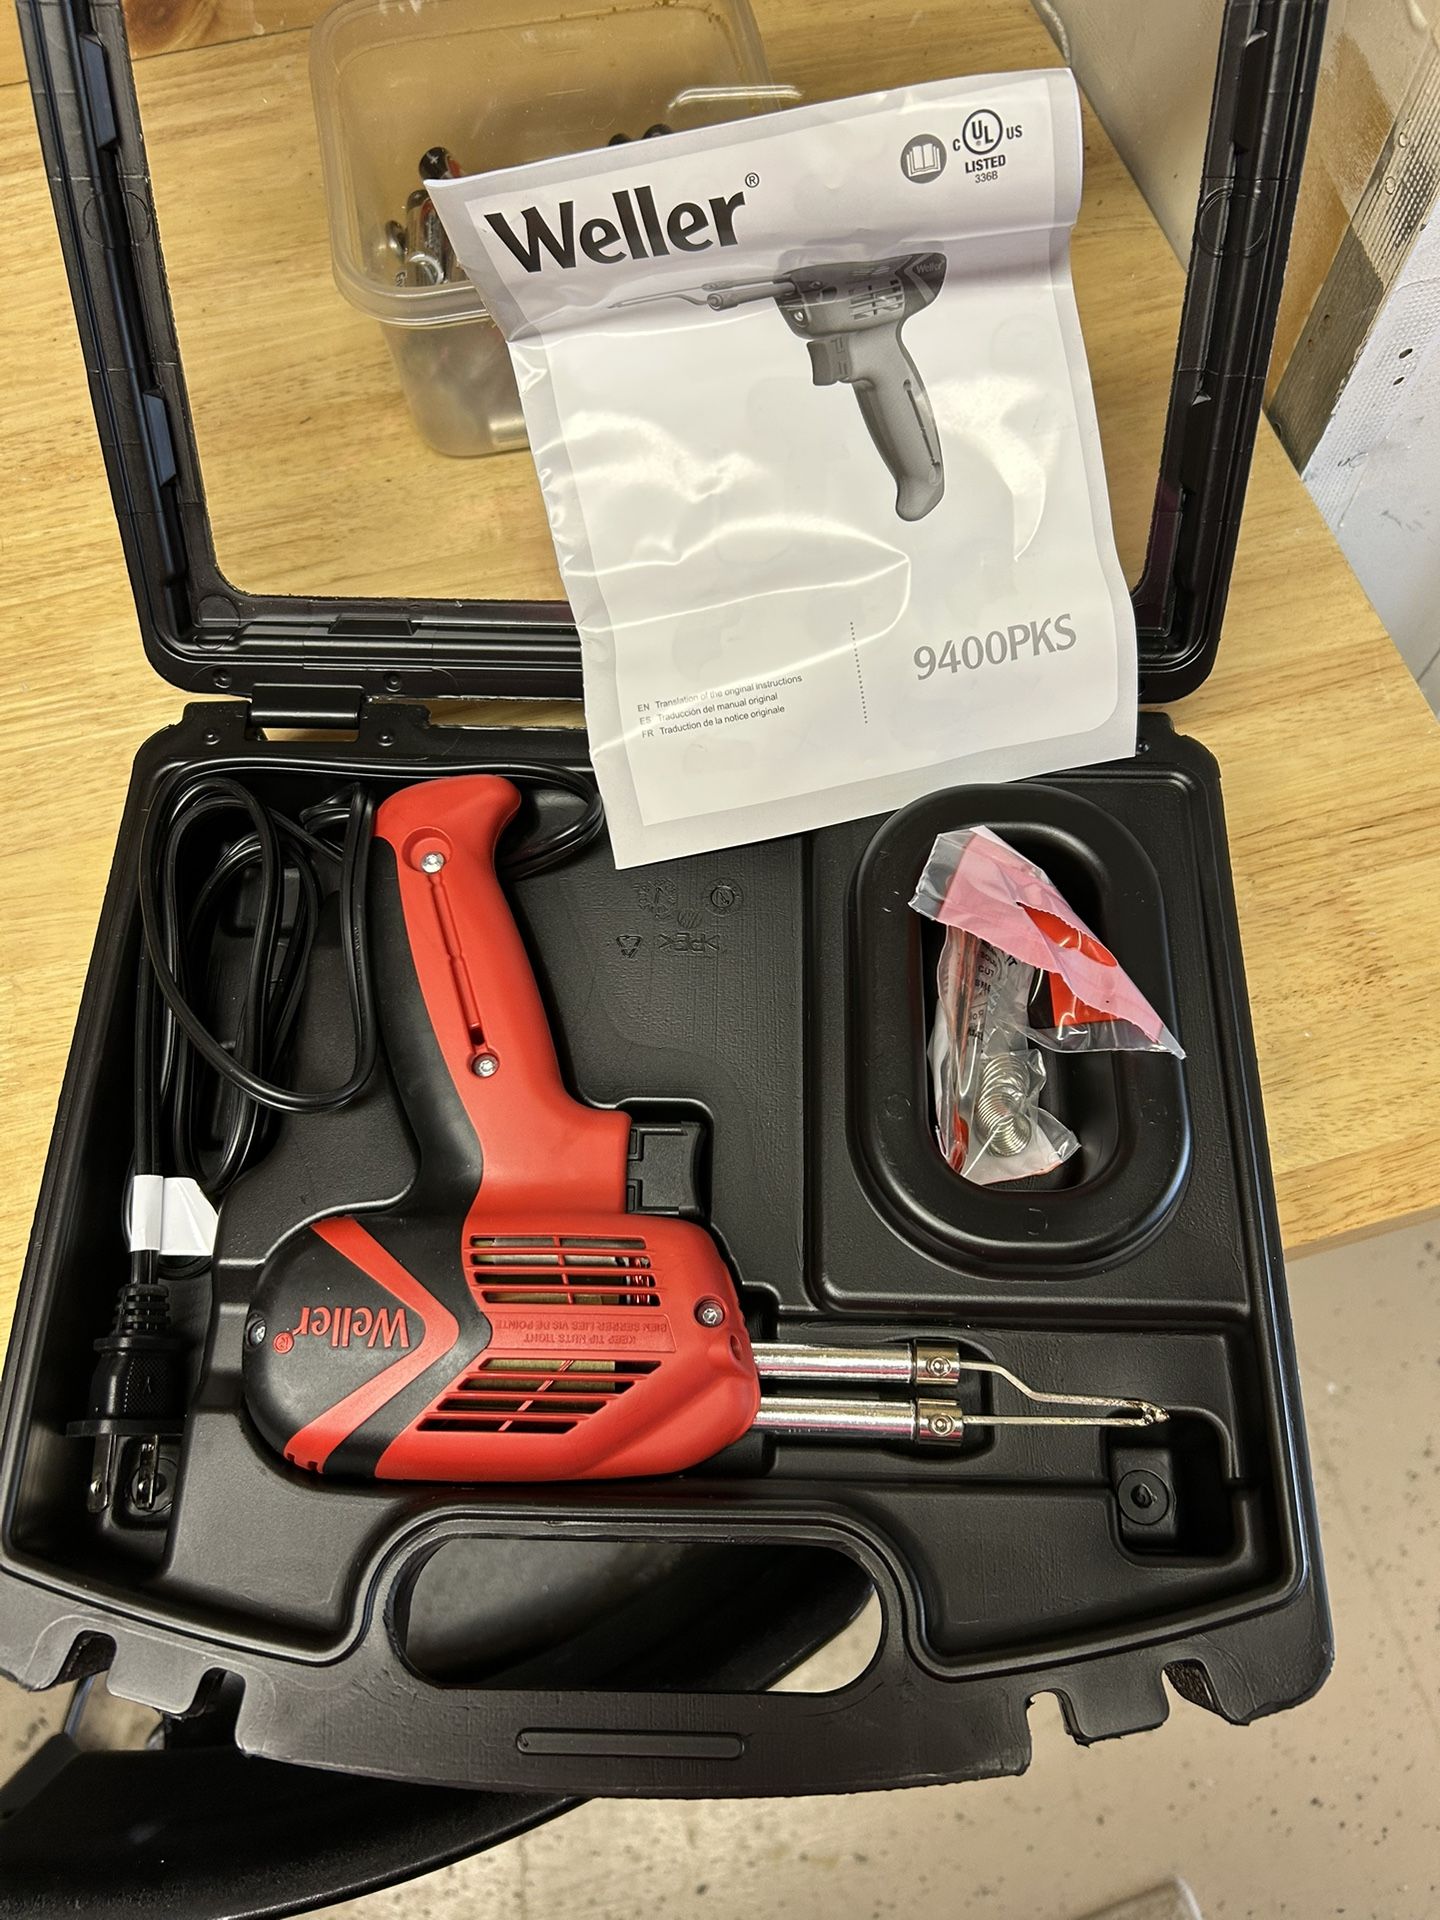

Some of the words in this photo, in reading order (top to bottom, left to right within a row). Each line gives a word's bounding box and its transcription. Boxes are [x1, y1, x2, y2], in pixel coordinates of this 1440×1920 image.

[971, 119, 995, 144] UL
[1005, 124, 1023, 140] US
[964, 154, 1007, 174] LISTED
[913, 613, 1077, 681] 9400PKS
[637, 703, 651, 713] EN
[655, 694, 699, 710] Translation
[724, 683, 754, 699] original
[755, 674, 803, 691] instructions
[639, 716, 652, 726] ES
[657, 707, 702, 722] Traducción
[702, 704, 716, 715] del
[716, 697, 747, 713] manual
[748, 692, 778, 708] original
[641, 729, 655, 739] FR
[659, 720, 702, 736] Traduction
[703, 717, 714, 728] de
[715, 714, 723, 726] la
[724, 710, 749, 725] notice
[750, 704, 786, 721] originale
[535, 1320, 550, 1331] DE
[552, 1320, 570, 1331] VIS
[523, 1333, 555, 1344] TIGHT
[558, 1334, 588, 1345] NUTS
[588, 1335, 606, 1345] TIP
[607, 1335, 637, 1346] KEEP
